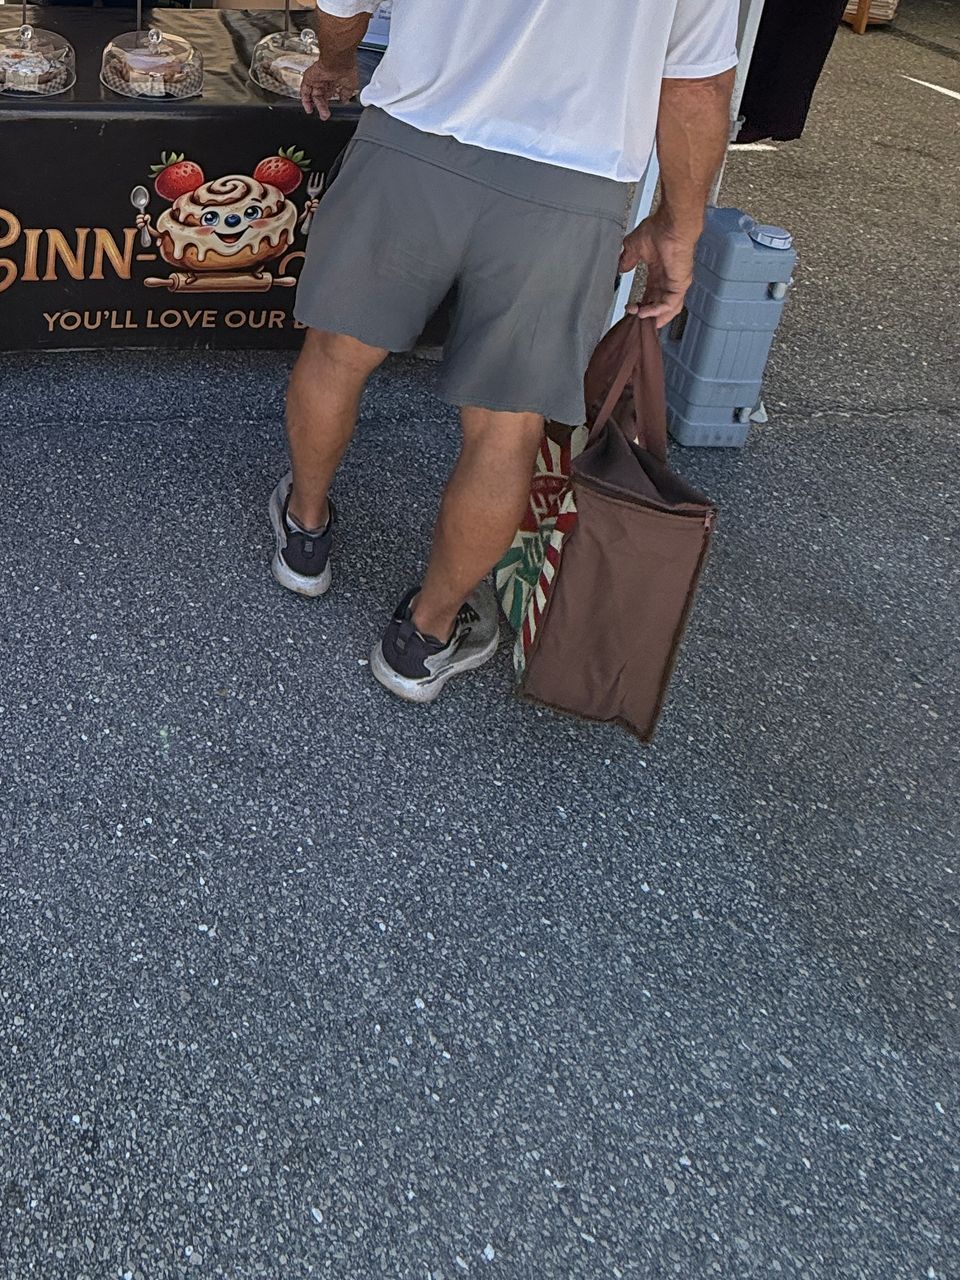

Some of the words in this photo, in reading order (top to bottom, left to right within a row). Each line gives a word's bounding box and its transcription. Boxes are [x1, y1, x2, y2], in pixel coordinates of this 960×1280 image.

[43, 311, 137, 332] YOU'LL
[145, 309, 218, 330] LOVE
[225, 310, 286, 329] OUR
